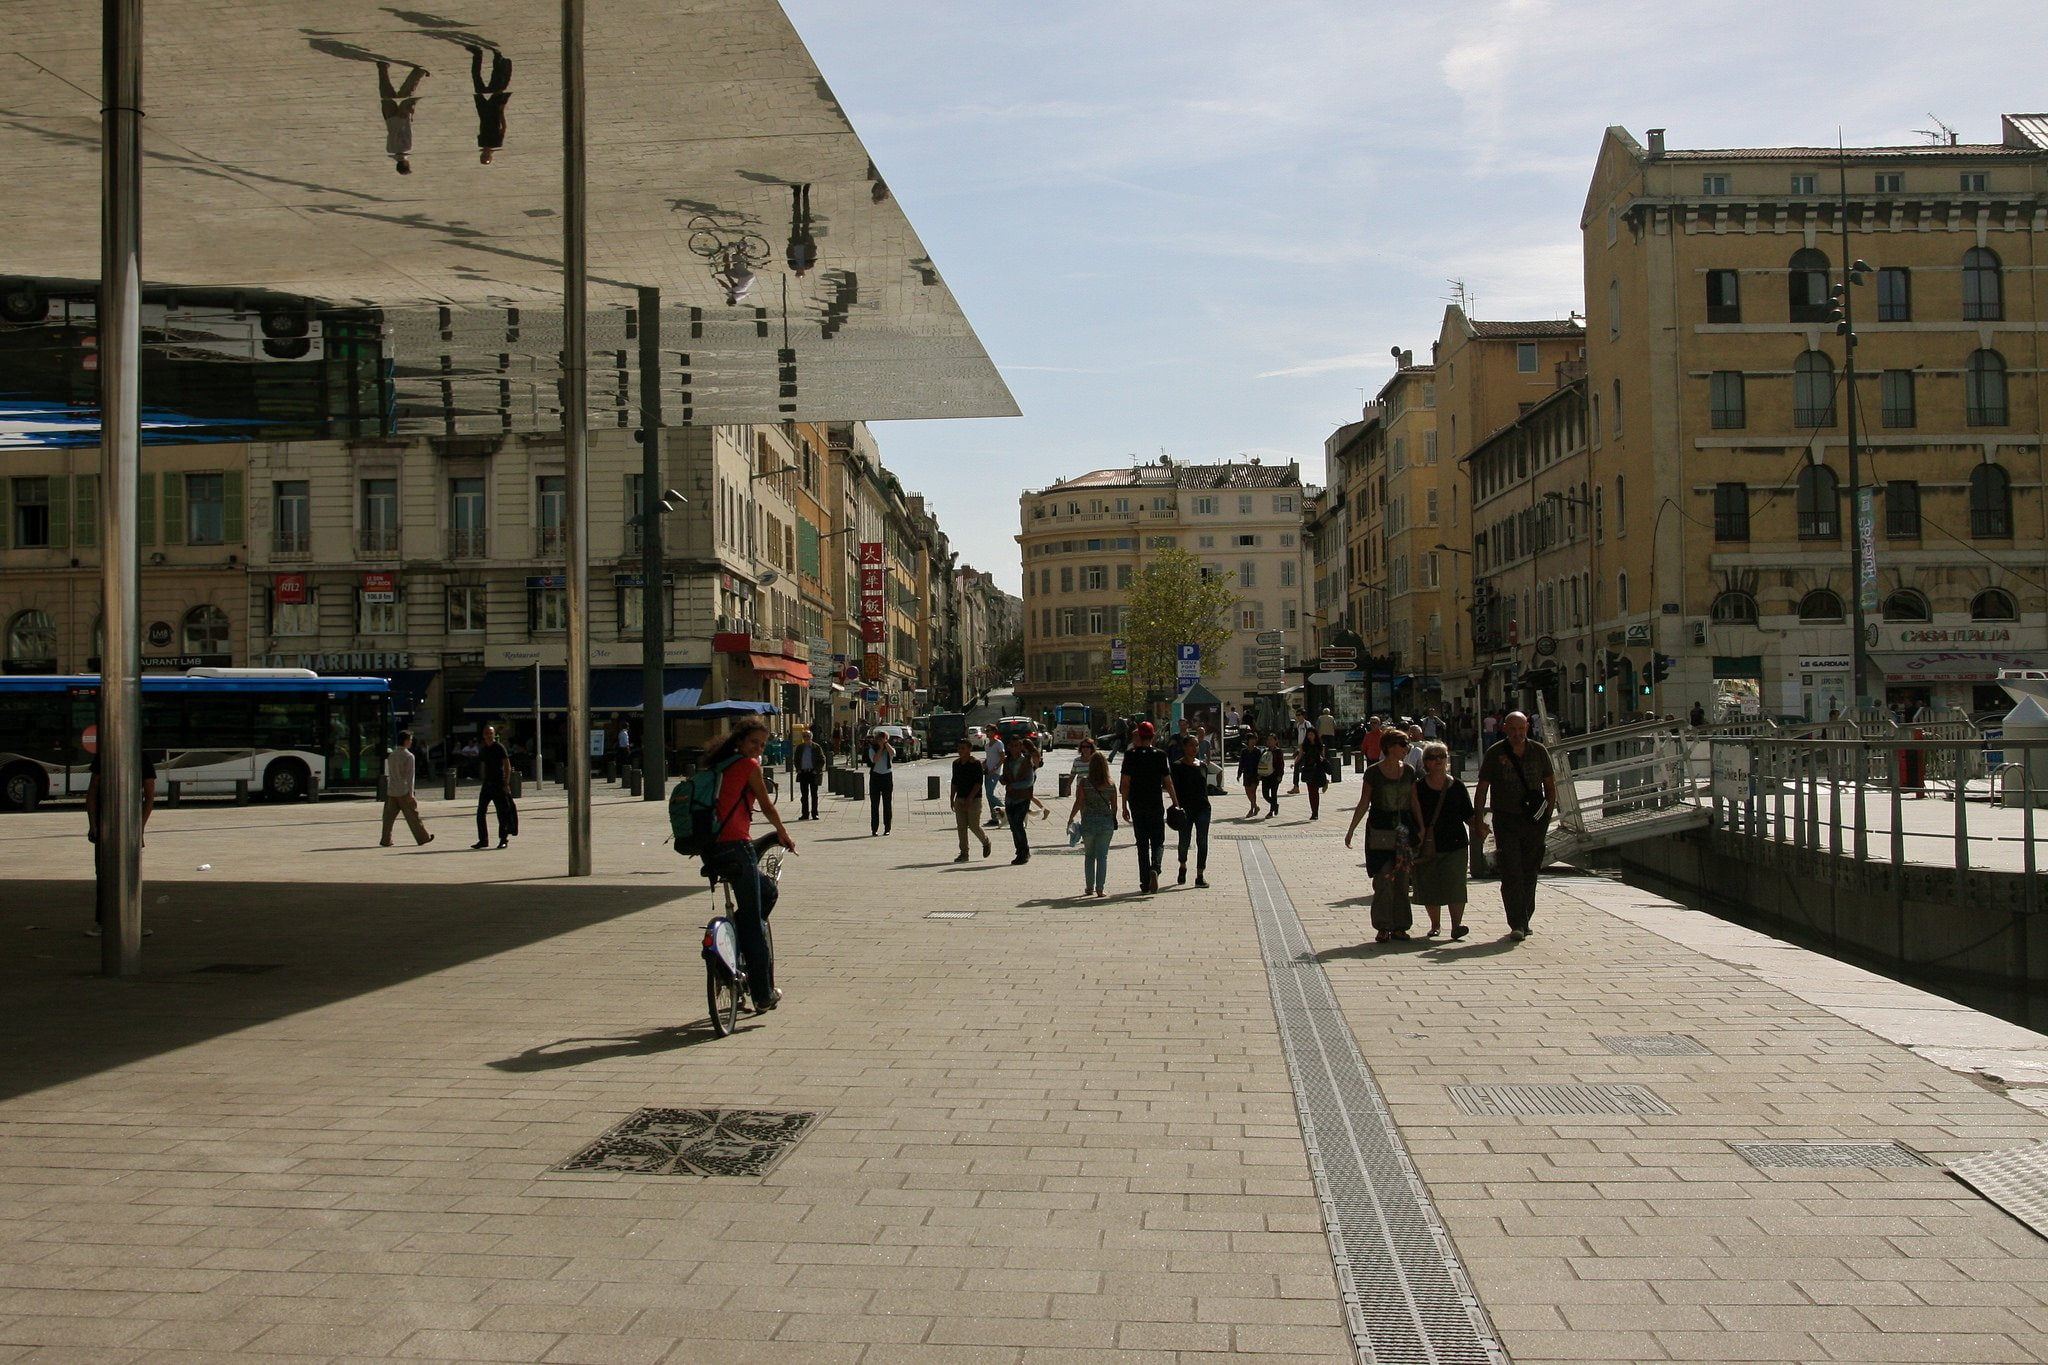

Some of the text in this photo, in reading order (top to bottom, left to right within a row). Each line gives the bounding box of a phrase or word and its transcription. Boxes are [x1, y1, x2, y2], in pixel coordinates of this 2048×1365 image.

[281, 583, 300, 592] RTL2
[152, 630, 169, 638] LMB
[1901, 629, 1949, 642] CASA
[502, 648, 689, 659] Restaurant Mer rasserie
[1183, 646, 1194, 659] P
[140, 658, 202, 666] AURANT LMB
[1905, 652, 2034, 671] GLACIER
